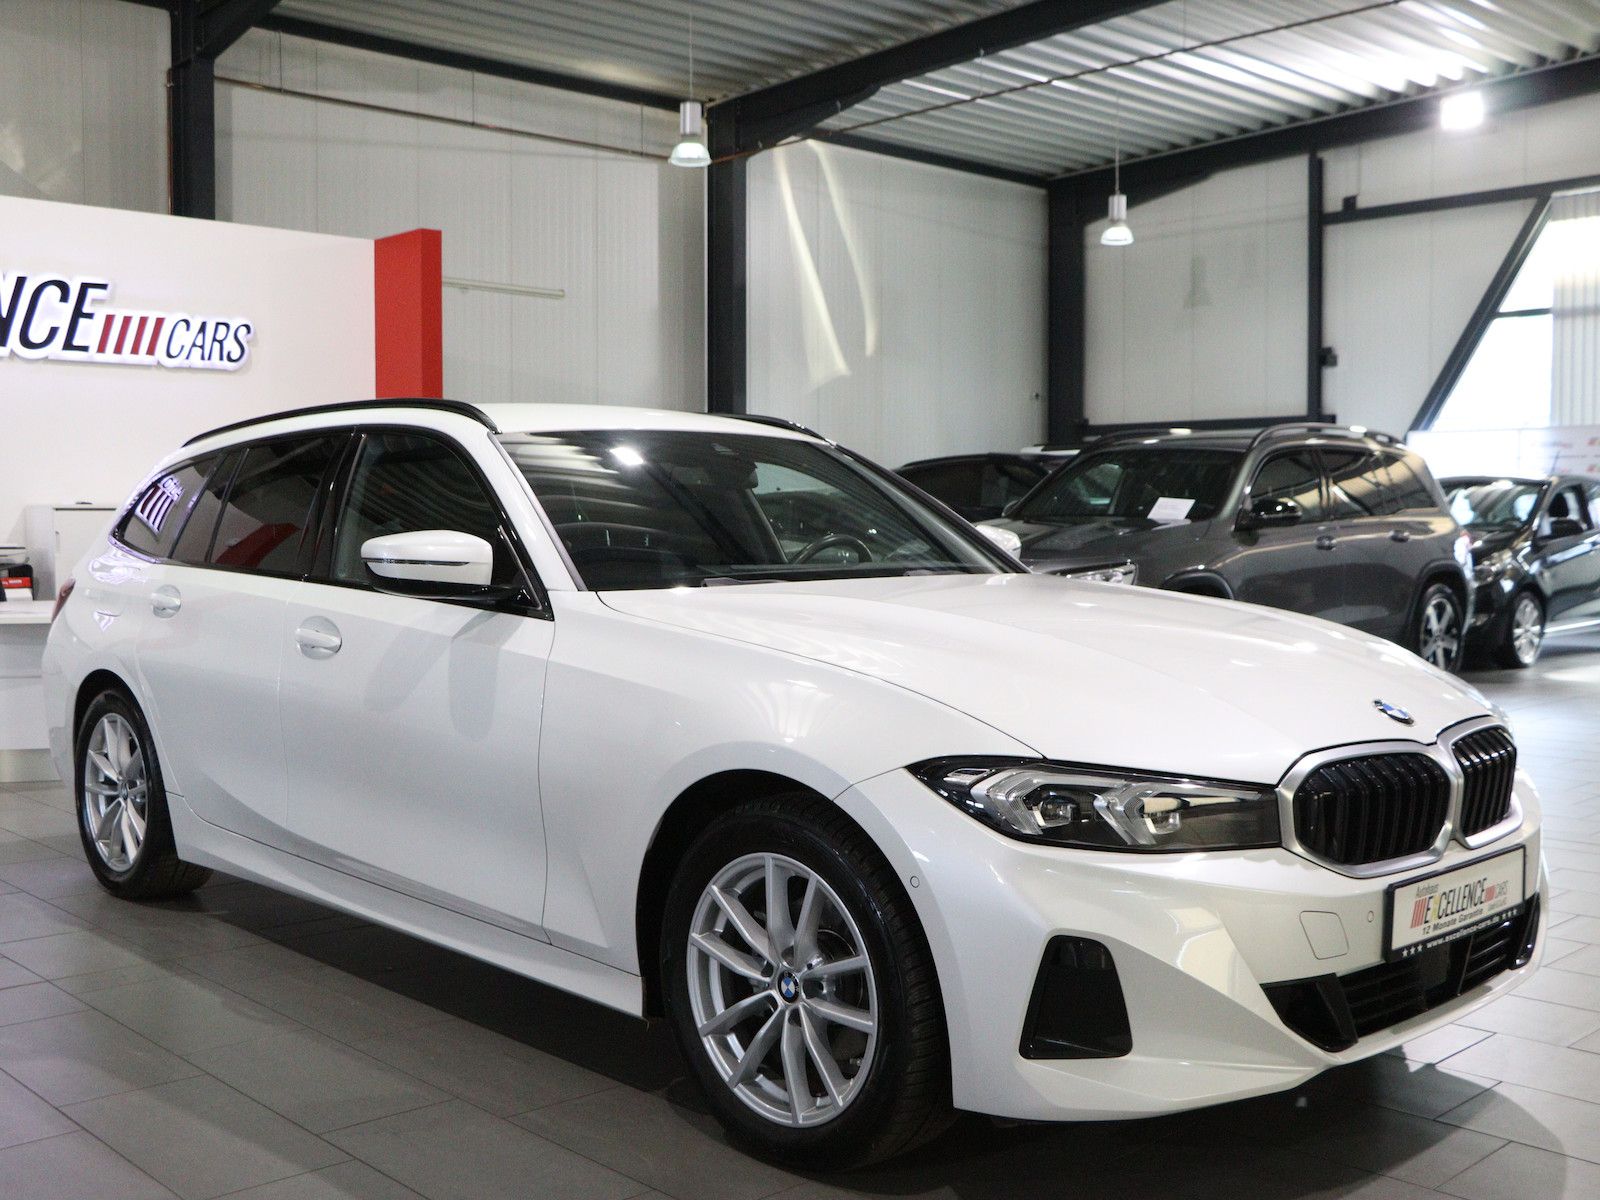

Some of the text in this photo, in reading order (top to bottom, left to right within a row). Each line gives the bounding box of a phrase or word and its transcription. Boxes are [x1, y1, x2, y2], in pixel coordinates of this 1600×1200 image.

[165, 318, 252, 363] CARS
[1422, 908, 1484, 935] 12 Monate Garantie
